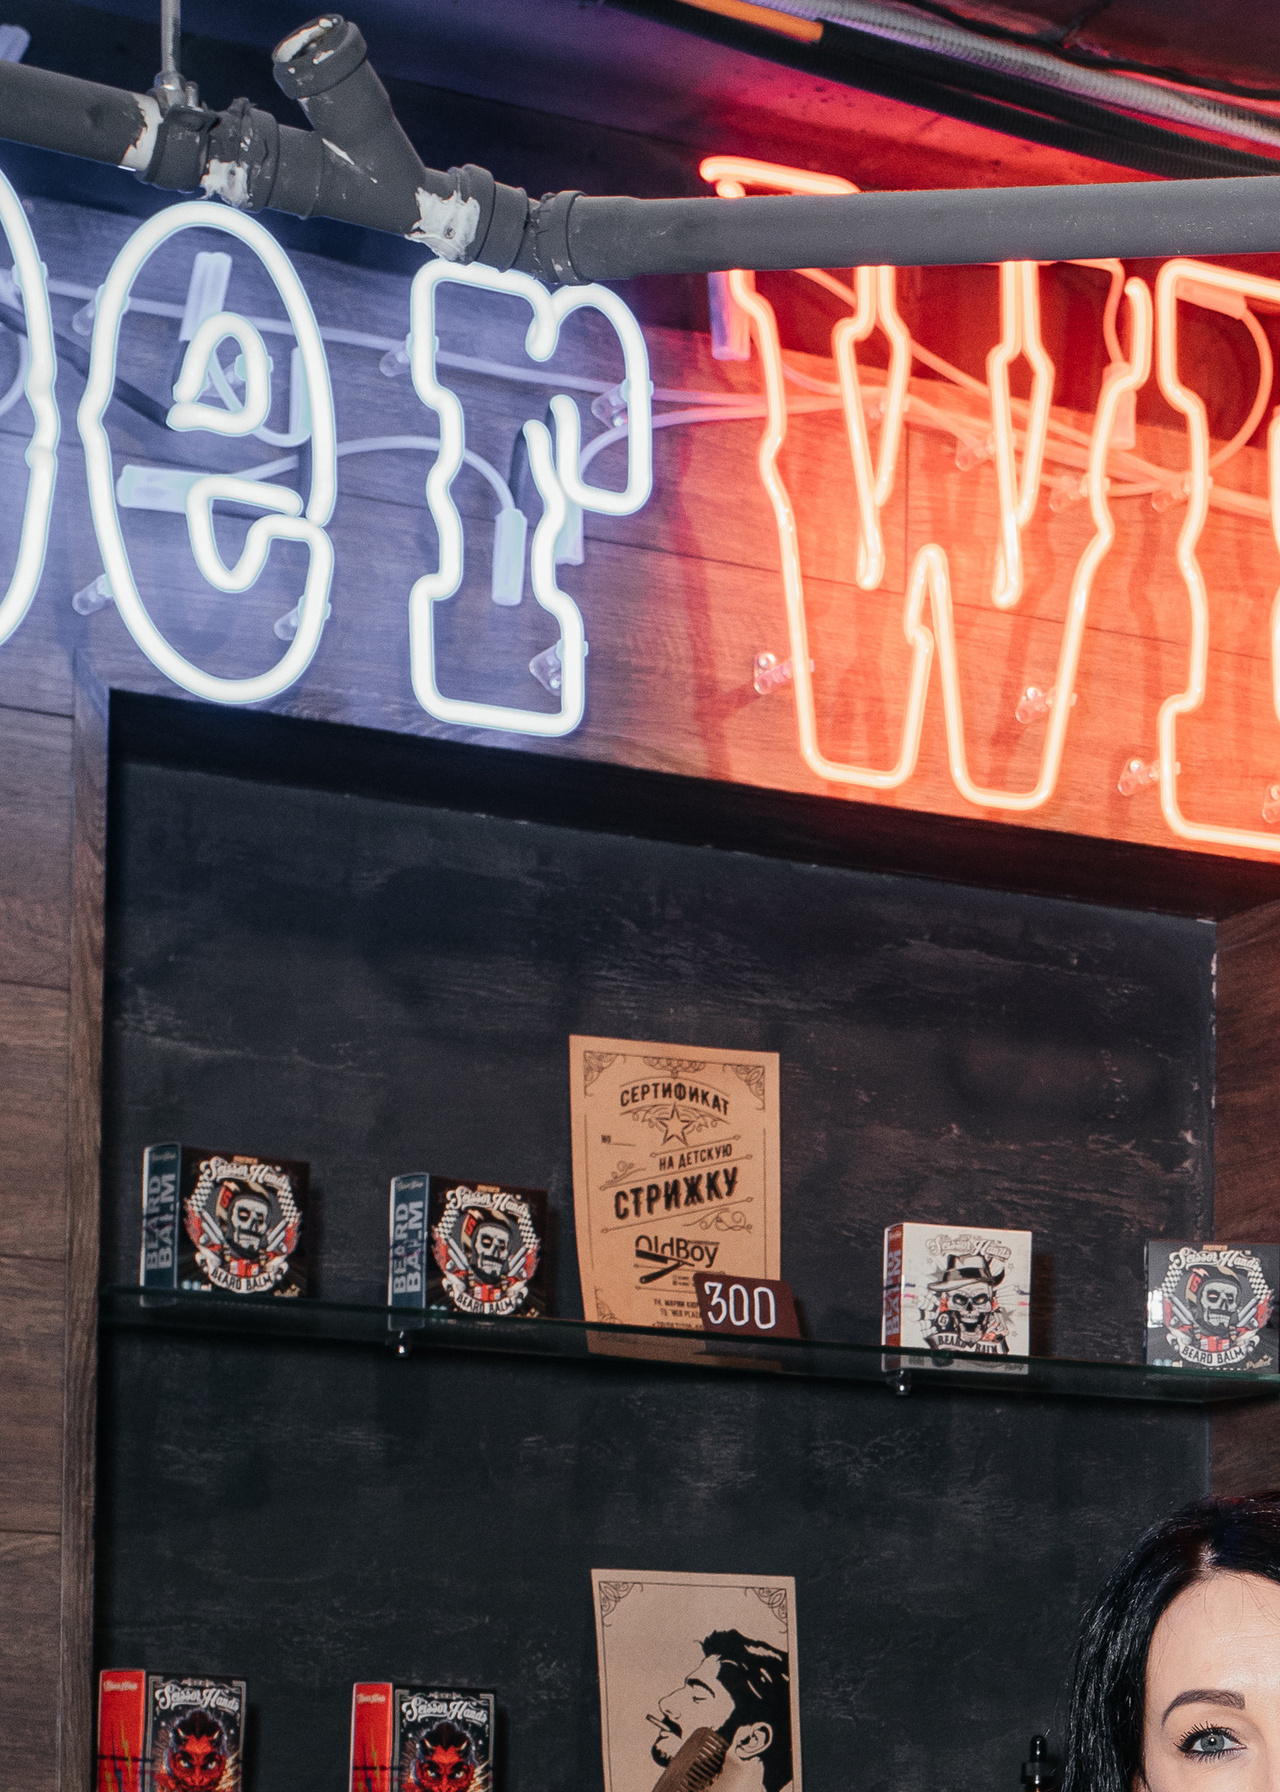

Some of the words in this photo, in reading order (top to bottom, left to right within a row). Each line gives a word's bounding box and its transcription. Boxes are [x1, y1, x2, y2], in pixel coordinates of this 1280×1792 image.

[620, 1082, 730, 1116] СЕРТИФИКАТ
[659, 1155, 674, 1171] НА
[678, 1144, 733, 1170] ДЕТСКУЮ
[614, 1166, 738, 1220] СТРИЖКУ
[145, 1174, 161, 1270] BEARD
[158, 1173, 175, 1268] BALM
[393, 1203, 409, 1294] BEARD
[406, 1201, 423, 1293] BALM
[635, 1235, 719, 1268] OldBoy
[1169, 1247, 1218, 1270] Scissor
[1219, 1250, 1261, 1272] Hands
[211, 1266, 241, 1290] BEARD
[246, 1272, 272, 1290] BALM
[704, 1281, 776, 1330] 300
[1181, 1345, 1213, 1364] BEARD
[1217, 1347, 1245, 1364] BALM
[154, 1684, 201, 1709] Scissor
[202, 1688, 240, 1713] Hands
[401, 1696, 447, 1722] Scissor
[448, 1701, 488, 1725] Hands
